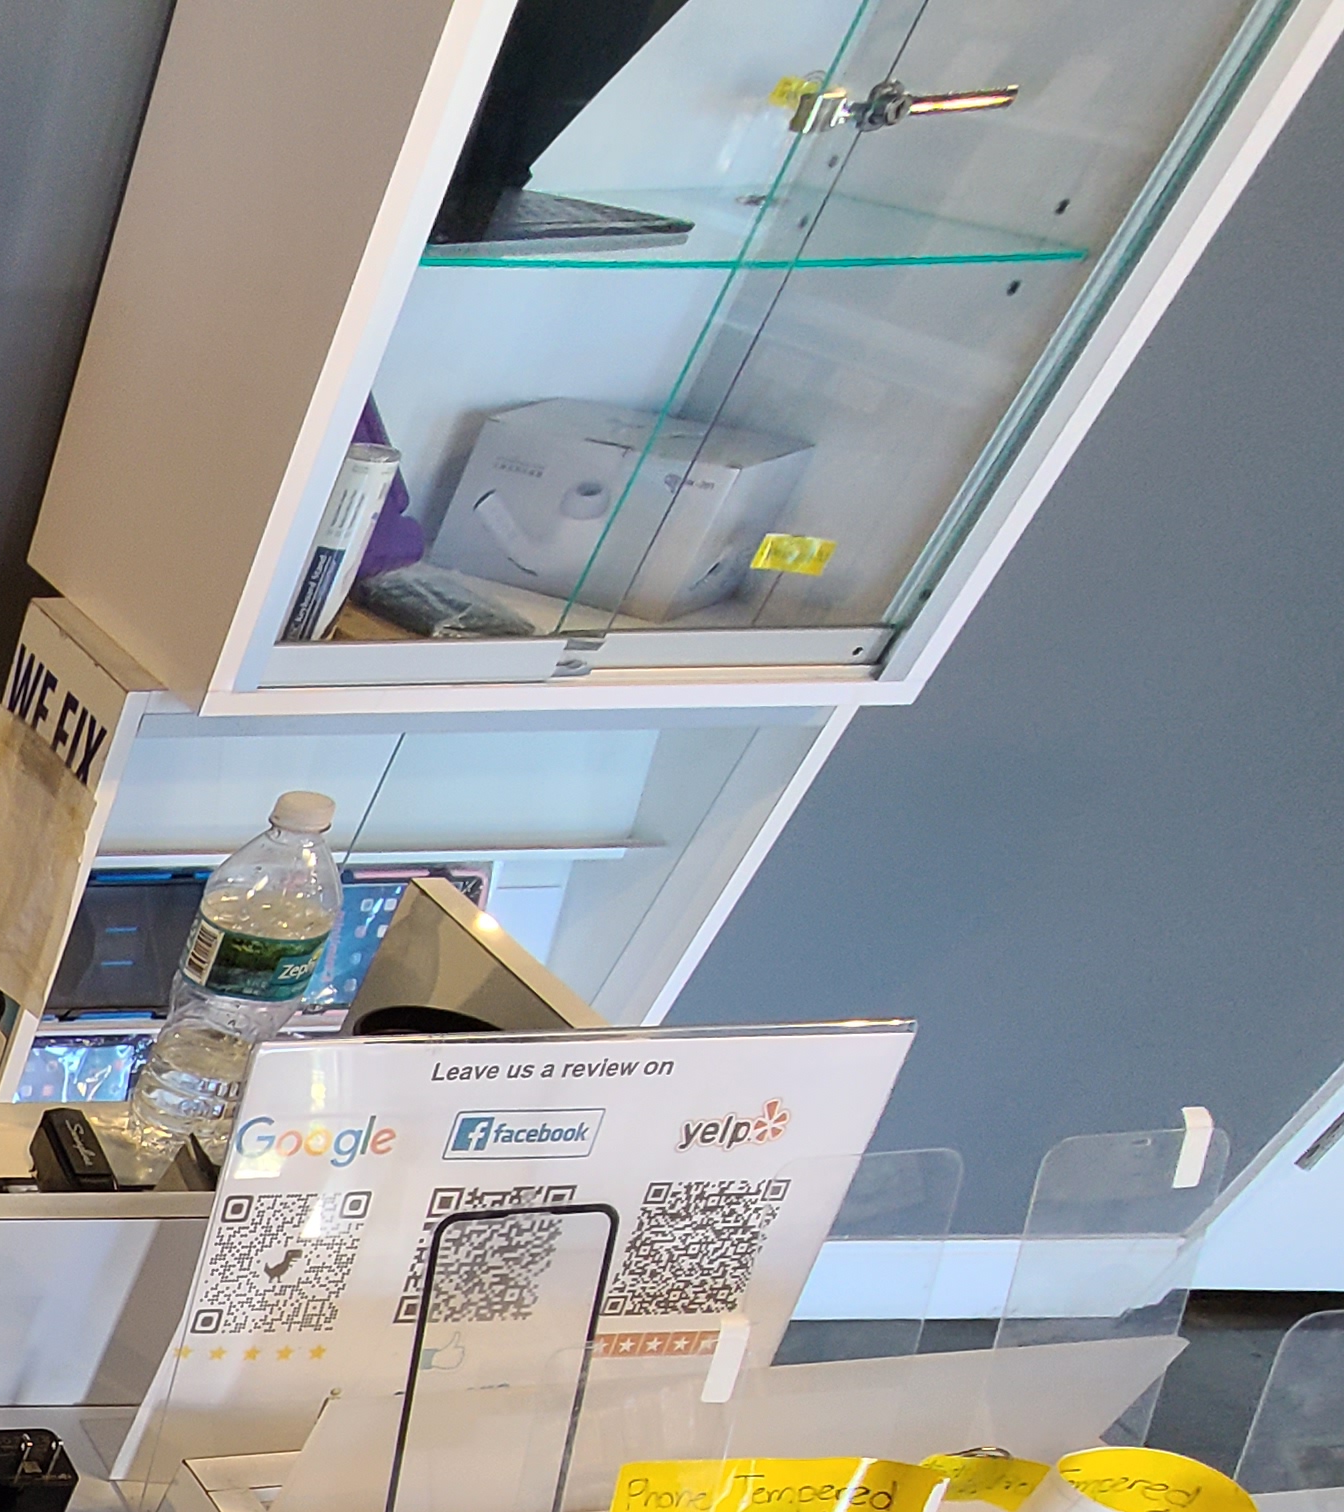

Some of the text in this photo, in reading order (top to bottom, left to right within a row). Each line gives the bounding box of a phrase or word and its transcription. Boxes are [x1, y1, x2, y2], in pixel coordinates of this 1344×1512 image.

[7, 643, 107, 786] WE FIX
[431, 1058, 675, 1081] Leave us a review on
[234, 1115, 397, 1168] Google
[493, 1122, 589, 1144] facebook
[676, 1115, 753, 1150] yelp
[626, 1478, 710, 1511] Phone
